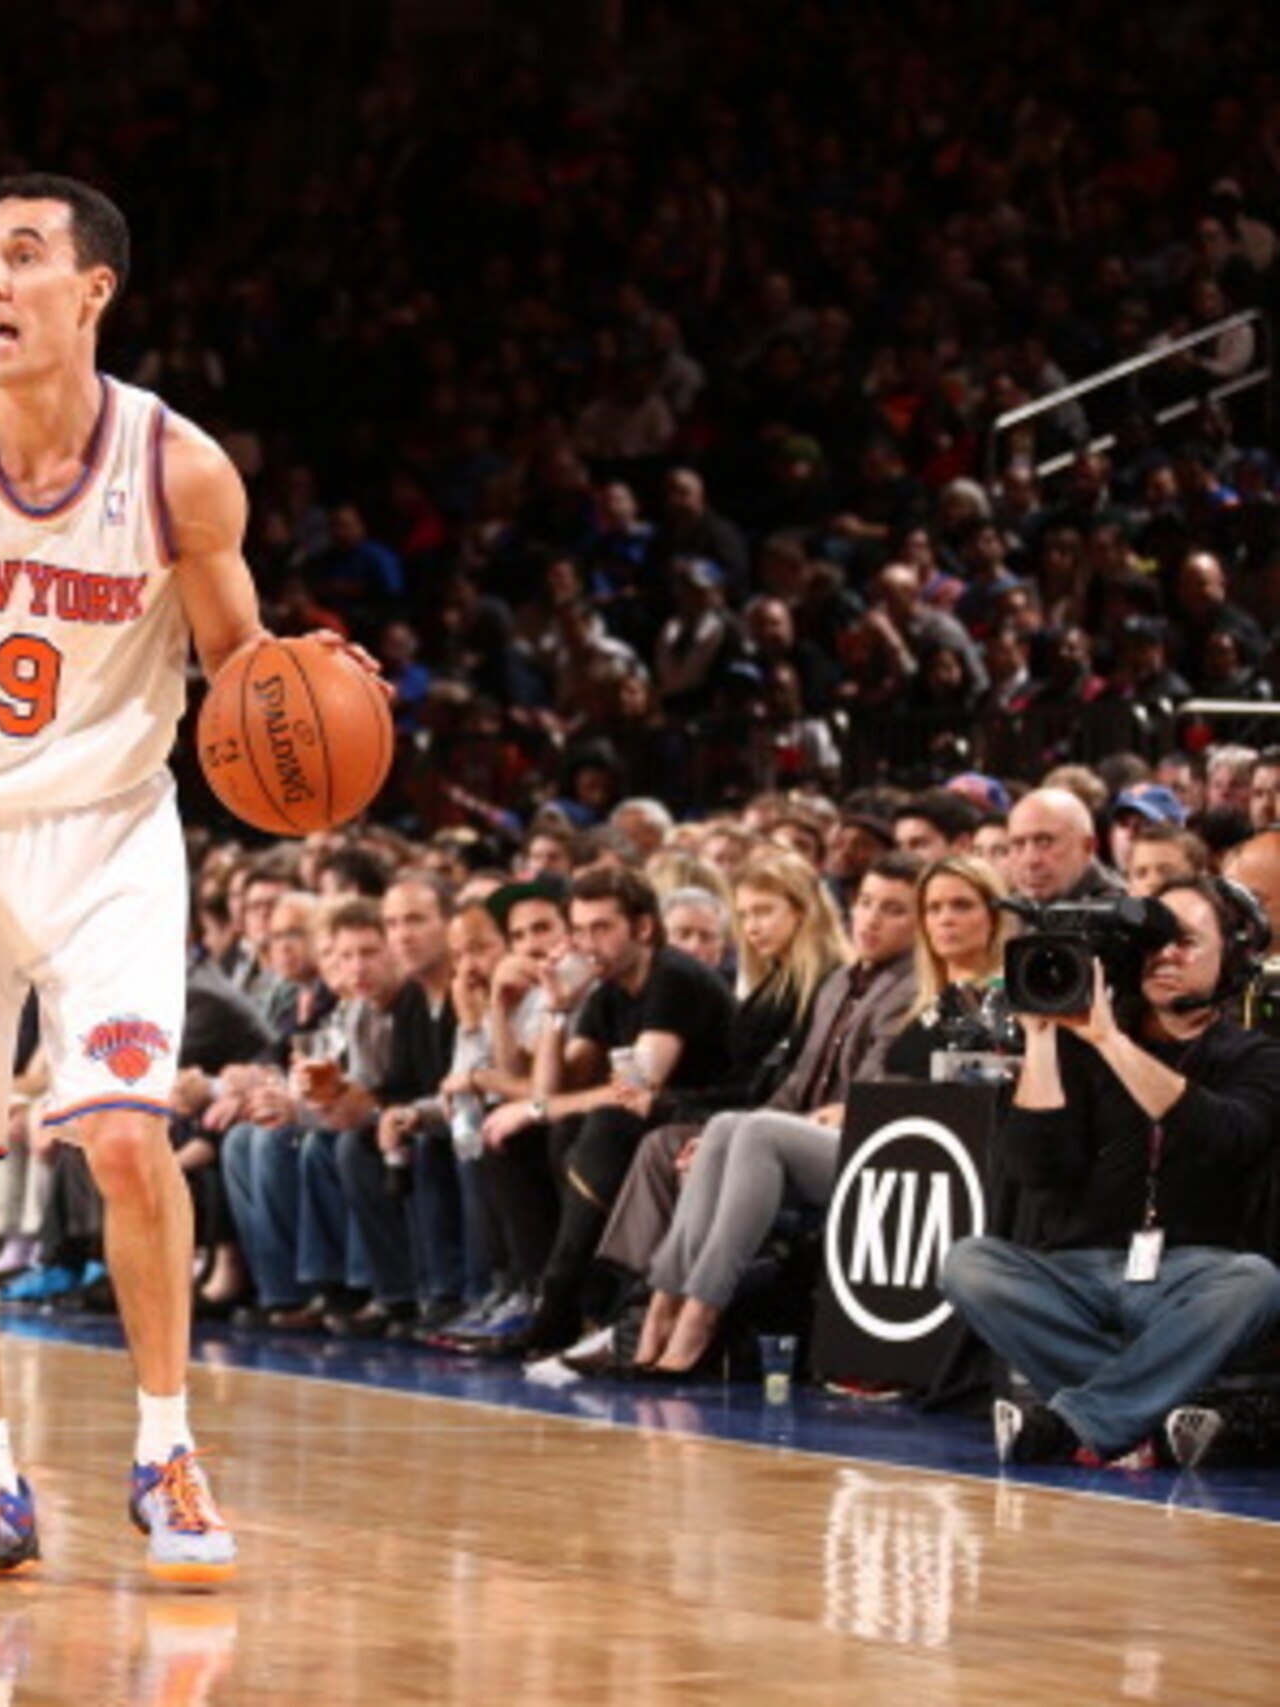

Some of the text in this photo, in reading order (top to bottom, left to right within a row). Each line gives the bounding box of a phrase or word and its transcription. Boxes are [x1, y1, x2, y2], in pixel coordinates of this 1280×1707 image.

[23, 560, 148, 625] YORK
[254, 674, 316, 804] SPALDING
[848, 1167, 953, 1290] KIA
